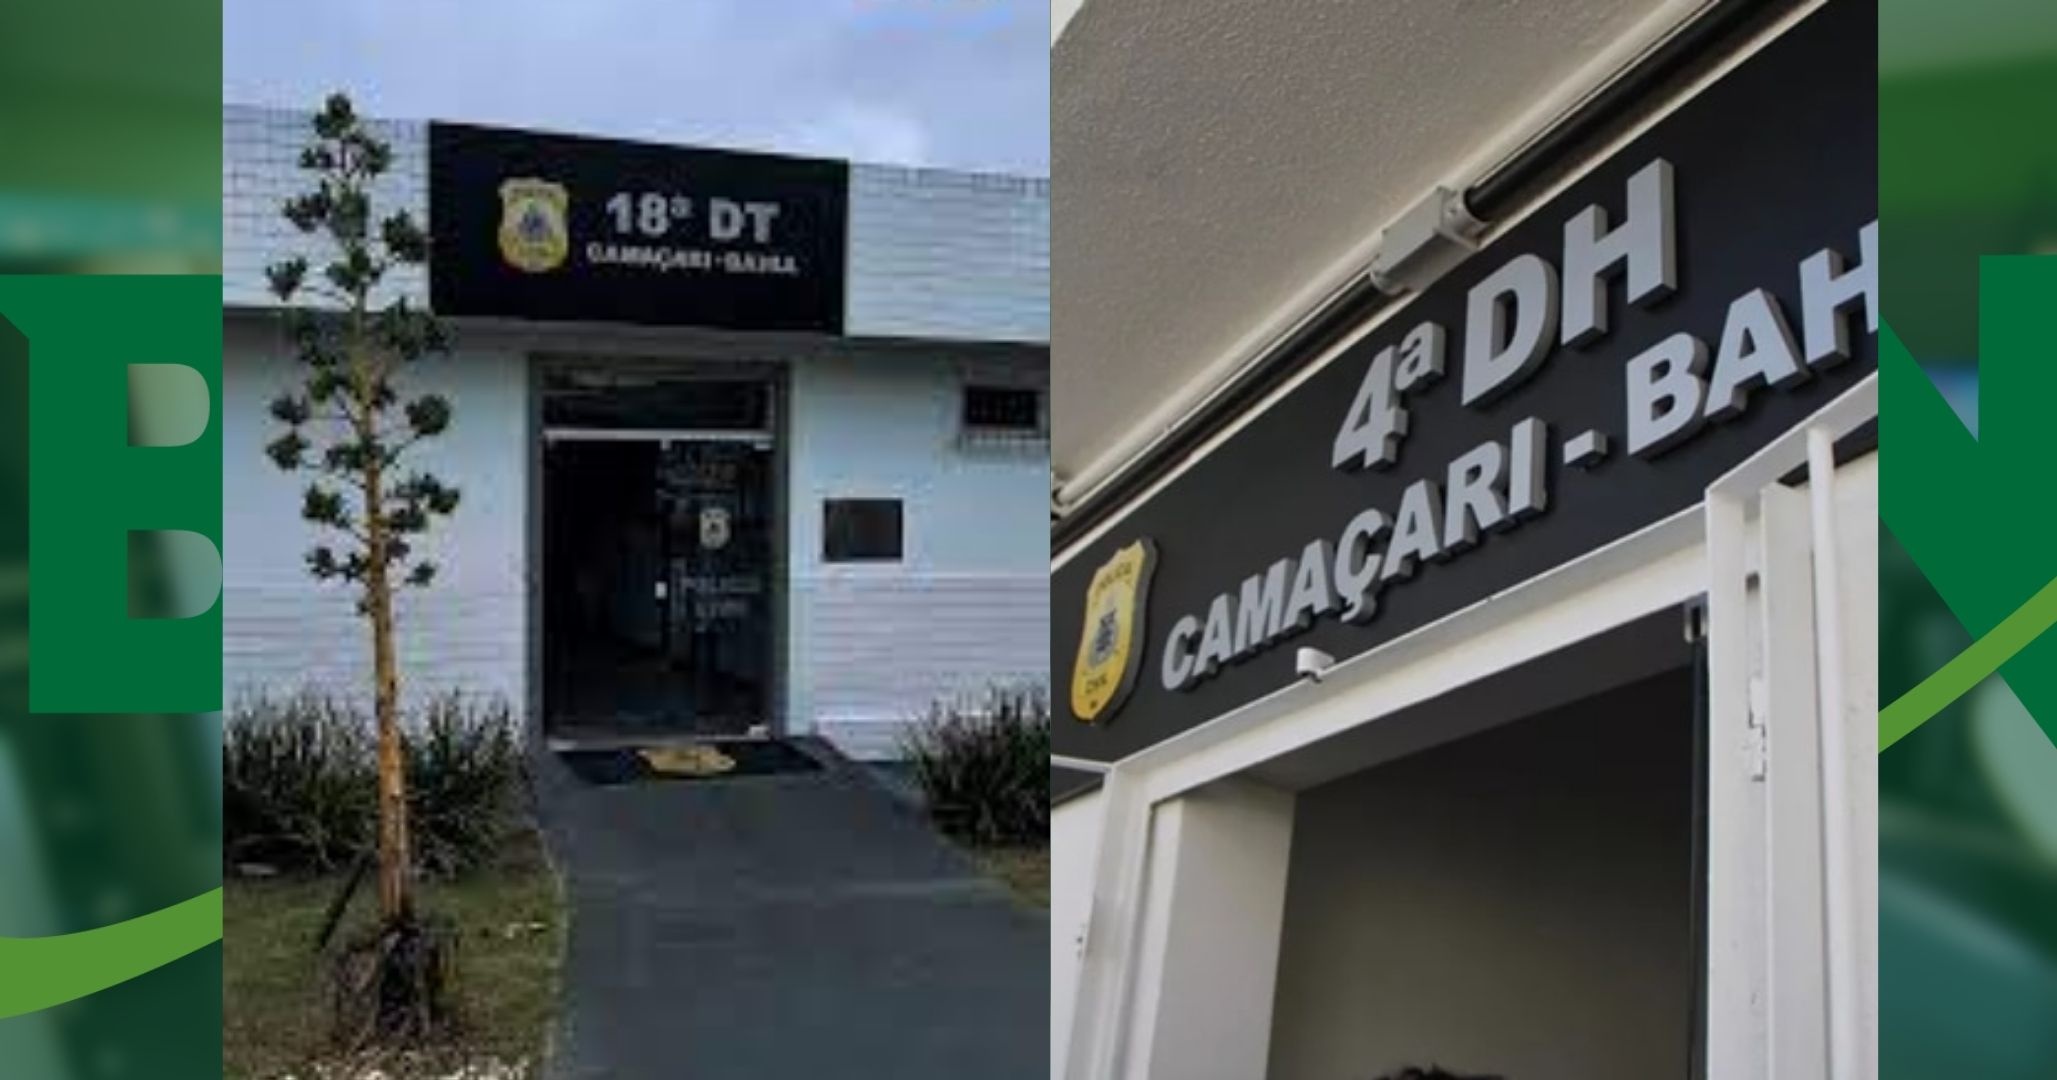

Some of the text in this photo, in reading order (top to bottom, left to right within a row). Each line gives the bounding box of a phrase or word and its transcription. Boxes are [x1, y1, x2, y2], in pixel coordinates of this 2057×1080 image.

[709, 197, 780, 243] DT
[1461, 157, 1677, 407] DH
[1161, 415, 1549, 693] CAMAÇARI
